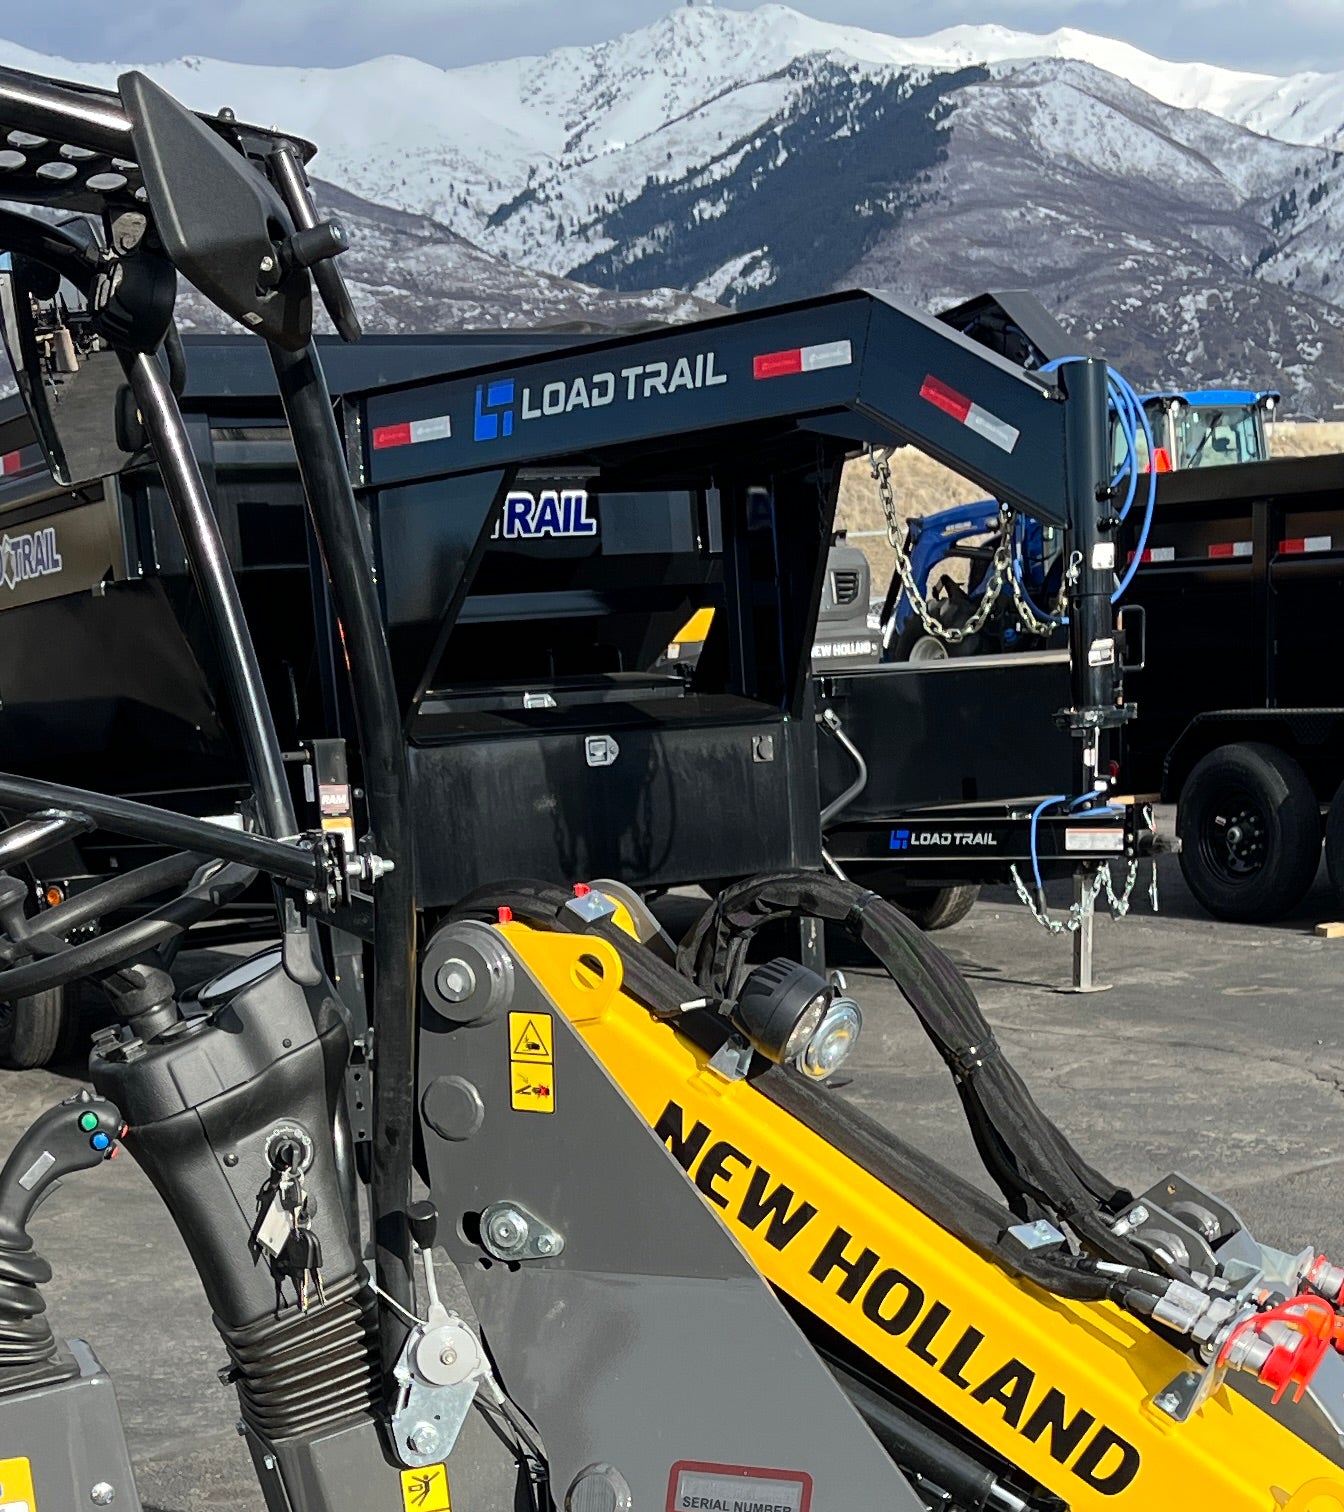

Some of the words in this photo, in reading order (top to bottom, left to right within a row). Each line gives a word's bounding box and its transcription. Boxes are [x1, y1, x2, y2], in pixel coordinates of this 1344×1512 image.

[521, 373, 615, 420] LOAD
[621, 351, 728, 400] TRAIL
[501, 490, 597, 538] RAIL
[11, 528, 62, 581] TRAIL
[833, 640, 872, 657] HOLLAND
[911, 832, 952, 845] LOAD
[953, 831, 997, 845] TRAIL
[656, 1099, 818, 1252] NEW
[809, 1226, 1142, 1497] HOLLAND
[682, 1494, 731, 1512] SERIAL
